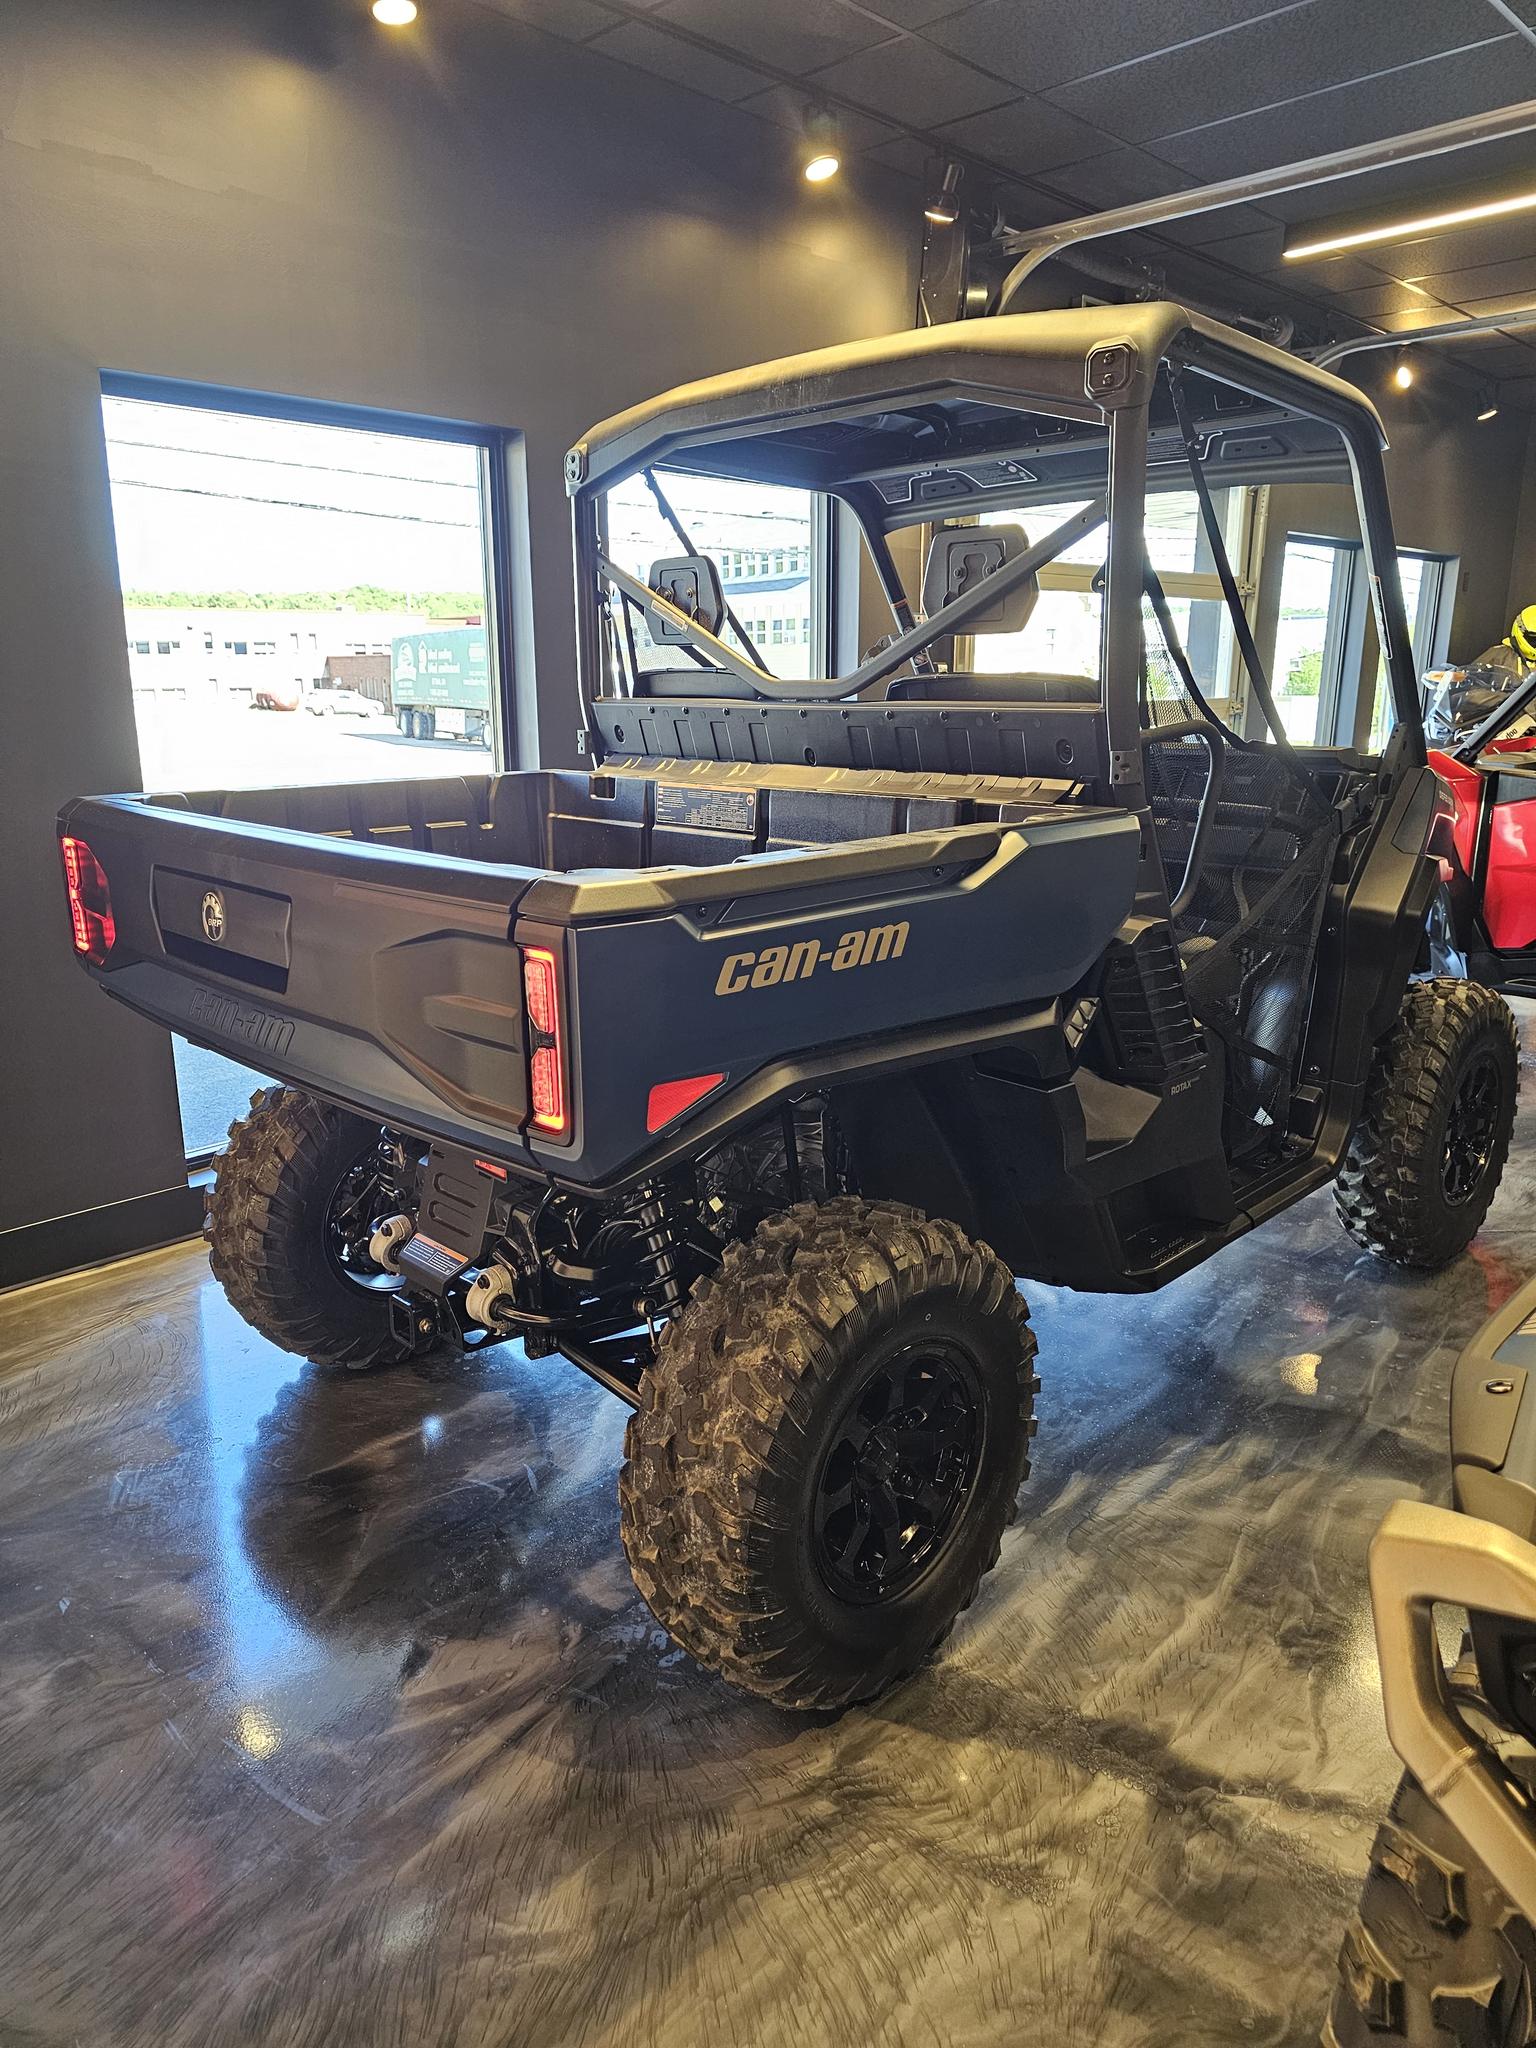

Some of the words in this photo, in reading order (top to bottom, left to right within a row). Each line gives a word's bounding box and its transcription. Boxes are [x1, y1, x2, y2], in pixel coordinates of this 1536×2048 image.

[207, 918, 222, 927] BRP
[714, 921, 910, 996] can-am
[1171, 1080, 1192, 1096] ROTAX
